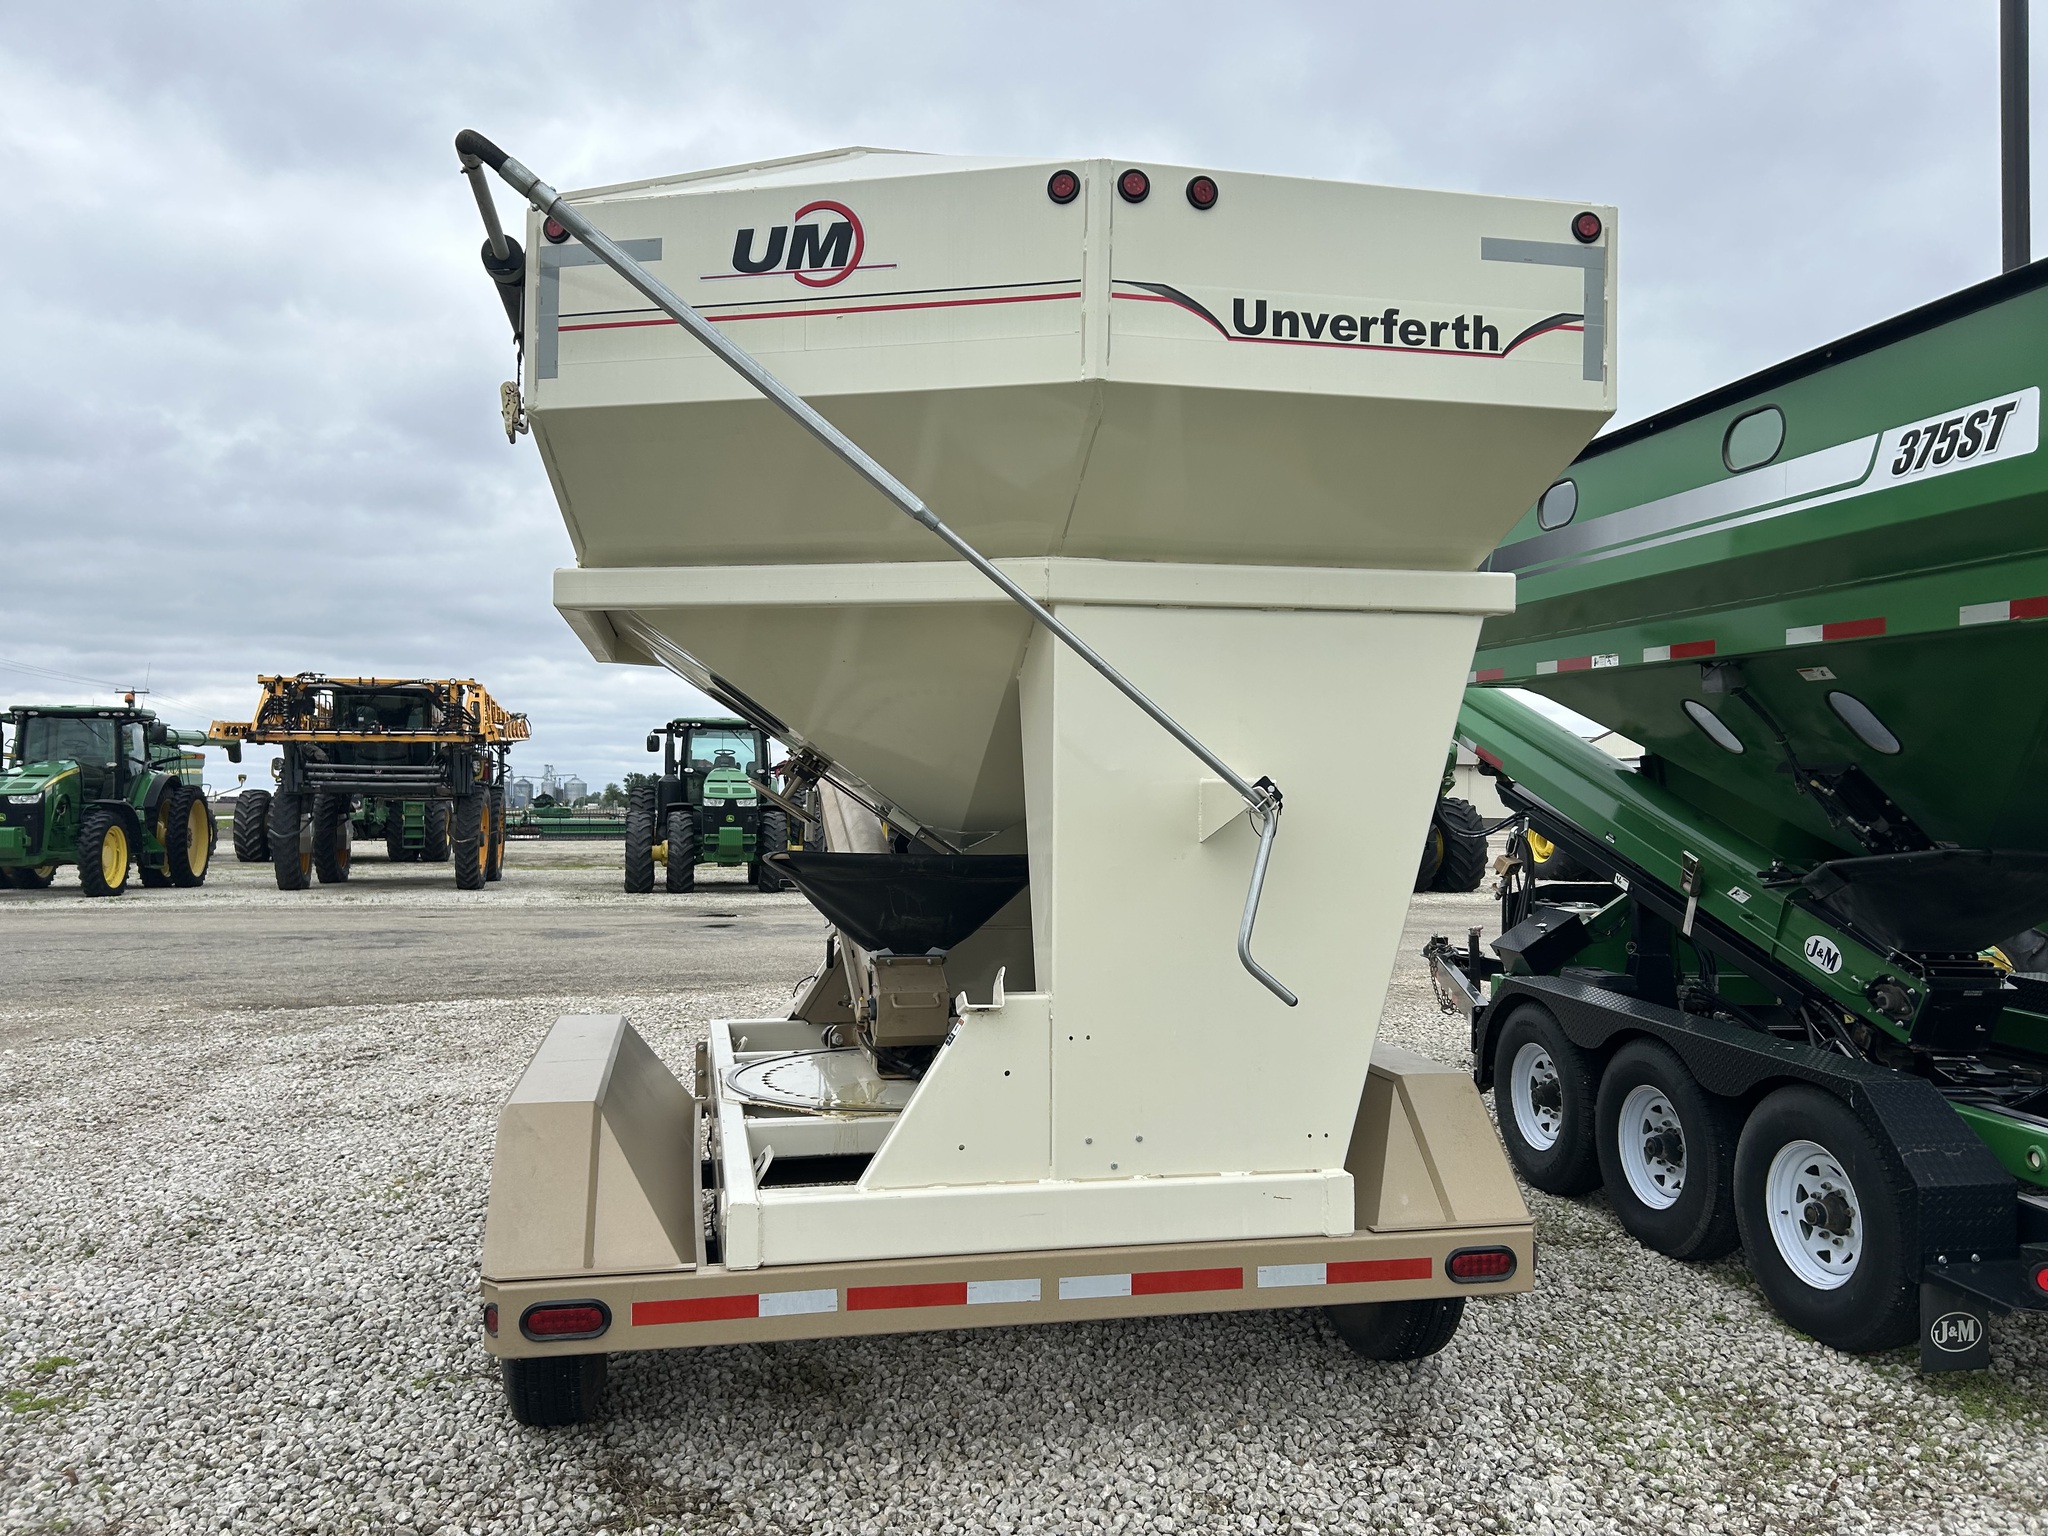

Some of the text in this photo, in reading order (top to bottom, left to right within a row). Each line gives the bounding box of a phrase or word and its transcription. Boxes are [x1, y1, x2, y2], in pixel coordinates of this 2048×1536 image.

[732, 221, 854, 274] UM
[1232, 297, 1500, 351] Unverferth
[1891, 400, 2018, 476] 375ST
[1806, 939, 1840, 972] J&M
[1933, 1319, 1975, 1344] J&M
